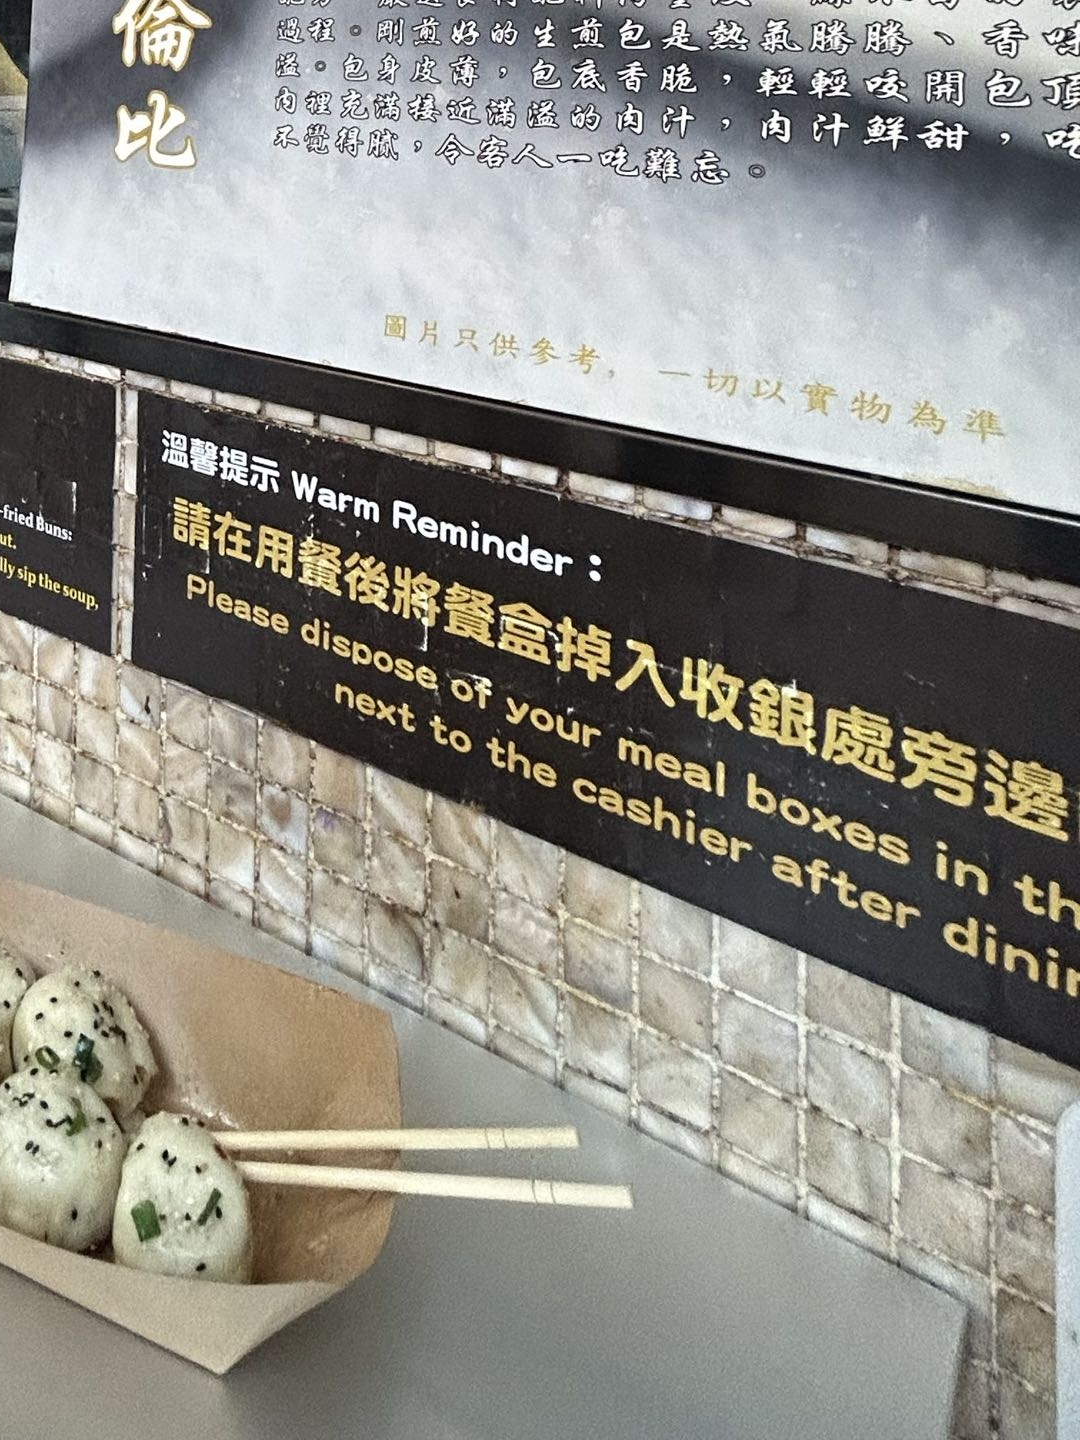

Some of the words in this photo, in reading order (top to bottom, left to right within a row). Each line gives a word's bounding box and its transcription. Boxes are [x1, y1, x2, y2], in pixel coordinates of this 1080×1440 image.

[36, 515, 73, 541] Buns:
[161, 429, 280, 493] 溫馨提示
[292, 470, 380, 523] Warm
[17, 565, 37, 587] sip
[38, 573, 61, 594] the
[62, 584, 99, 611] soup,
[172, 496, 1080, 842] 請在用餐後將餐盒掉入收銀處旁邊
[187, 574, 290, 636] Please
[301, 619, 437, 691] dispose
[451, 670, 493, 709] of
[506, 696, 601, 748] your
[618, 736, 726, 797] meal
[747, 773, 911, 866] boxes
[936, 841, 989, 896] in
[335, 682, 416, 733] next
[430, 714, 472, 755] to
[487, 737, 557, 790] the
[572, 774, 752, 863] cashier
[772, 854, 921, 929] after
